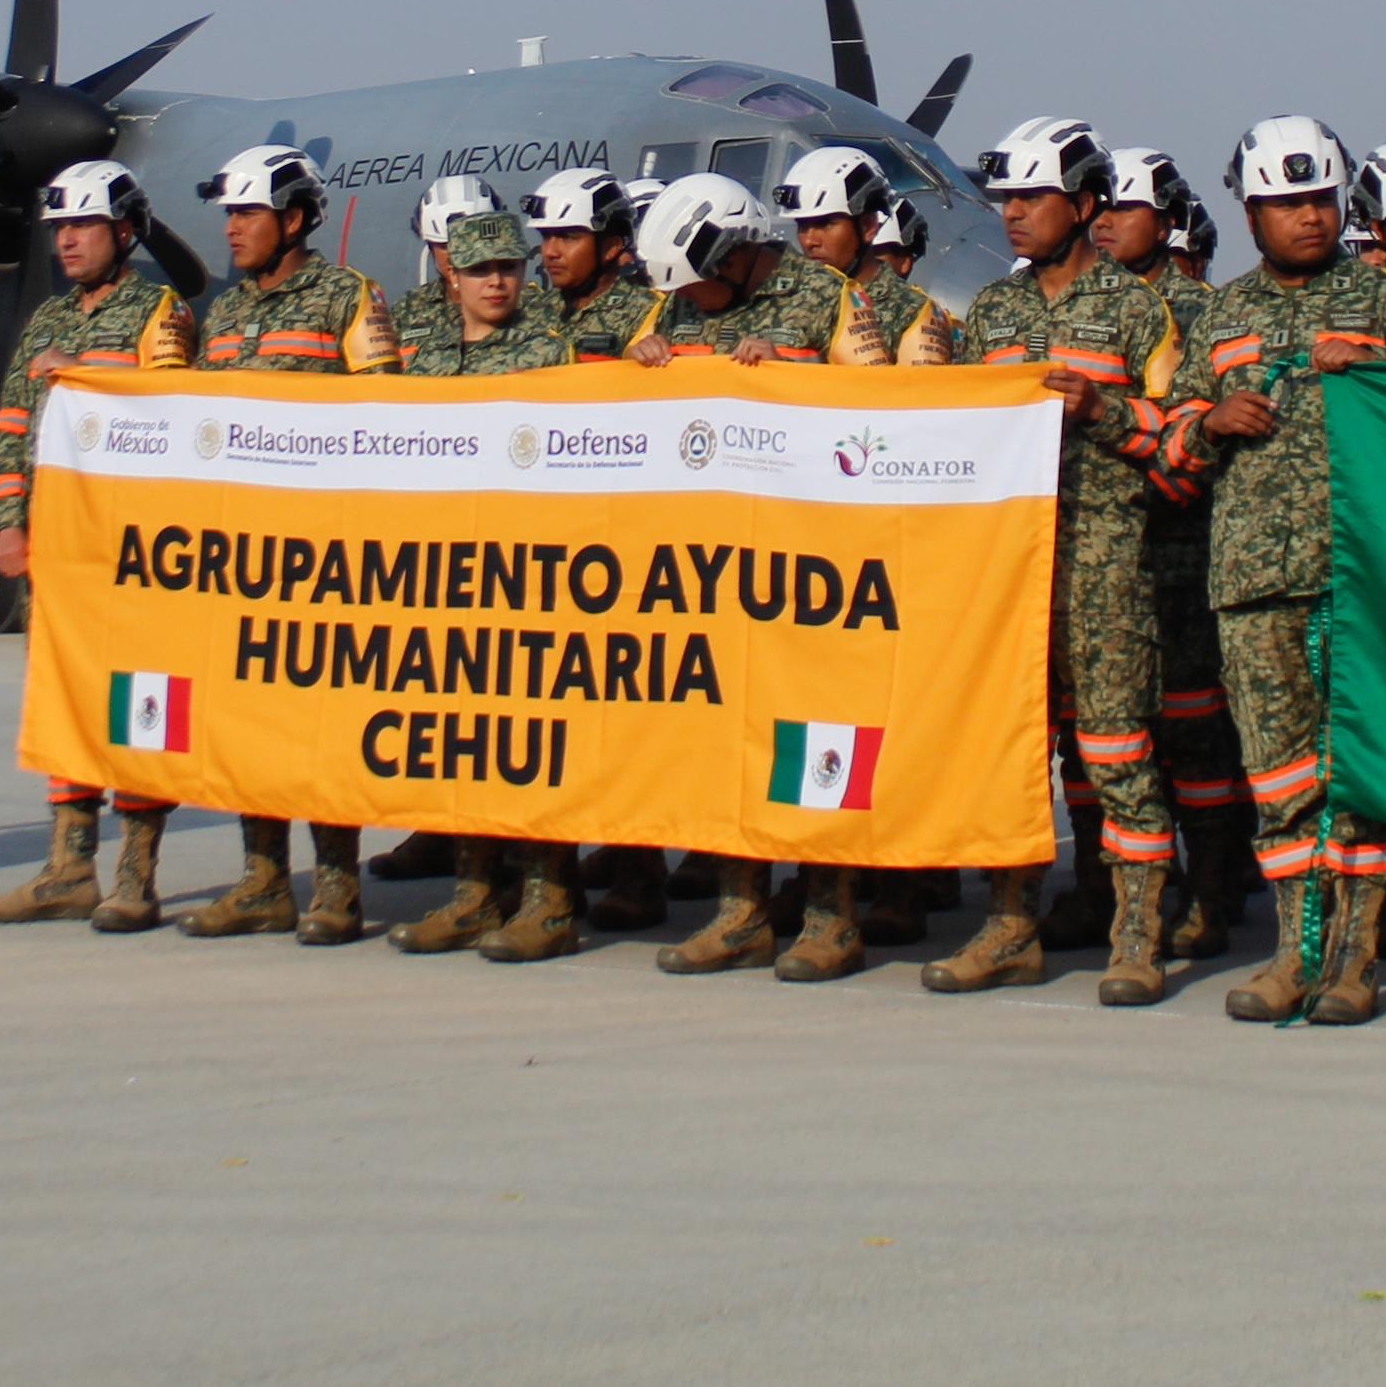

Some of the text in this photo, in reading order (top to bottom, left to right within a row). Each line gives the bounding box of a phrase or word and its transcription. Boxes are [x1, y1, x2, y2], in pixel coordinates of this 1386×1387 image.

[327, 139, 612, 190] AEREA MEXICANA
[110, 418, 170, 431] Gobierno de
[228, 423, 480, 457] Relaciones Exteriores
[723, 424, 787, 453] CNPC
[105, 430, 169, 455] México
[546, 427, 648, 456] Defensa
[871, 460, 976, 477] CONAFOR
[115, 524, 900, 631] AGRUPAMIENTO AYUDA
[236, 616, 723, 705] HUMANITARIA
[361, 709, 567, 787] CEHUI
